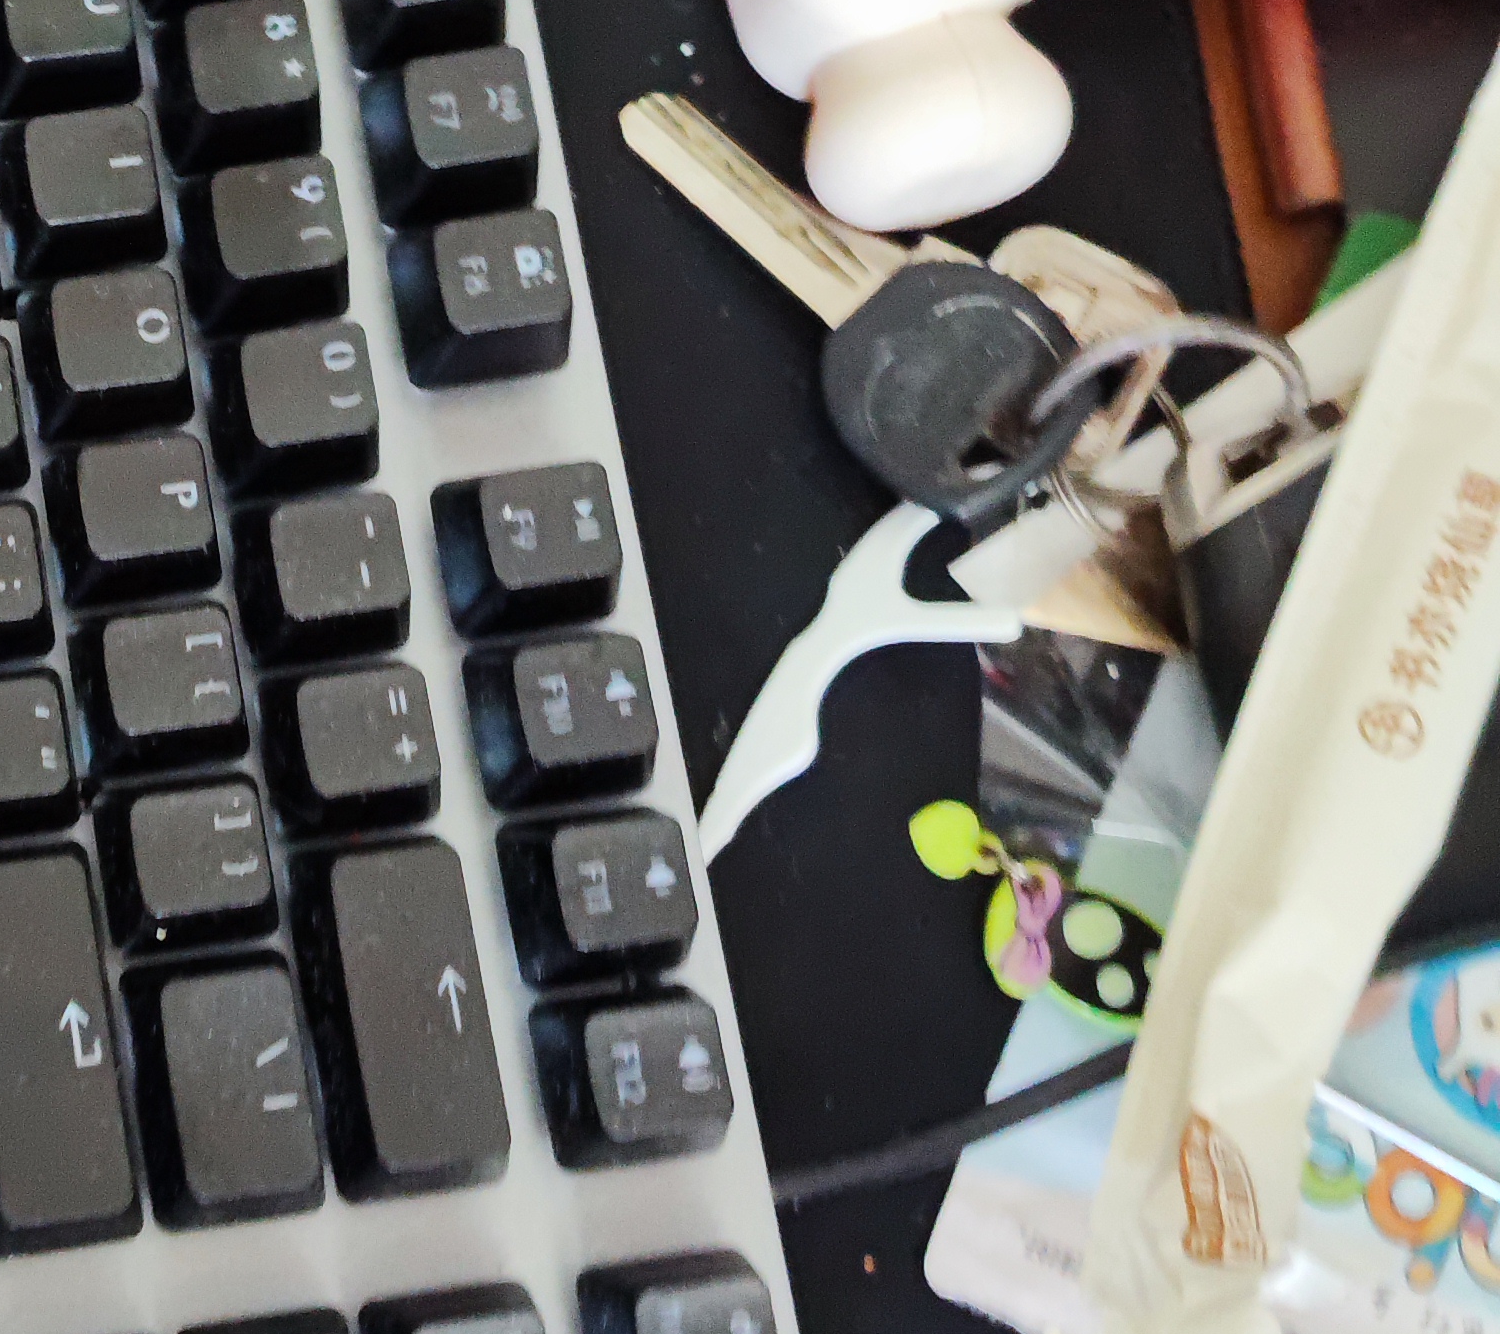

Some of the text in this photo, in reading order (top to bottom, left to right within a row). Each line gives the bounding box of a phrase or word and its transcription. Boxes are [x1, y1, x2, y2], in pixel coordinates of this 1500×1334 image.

[265, 15, 297, 41] 8
[291, 175, 325, 204] 9
[136, 308, 171, 344] O
[322, 340, 356, 372] 0
[160, 480, 199, 509] P
